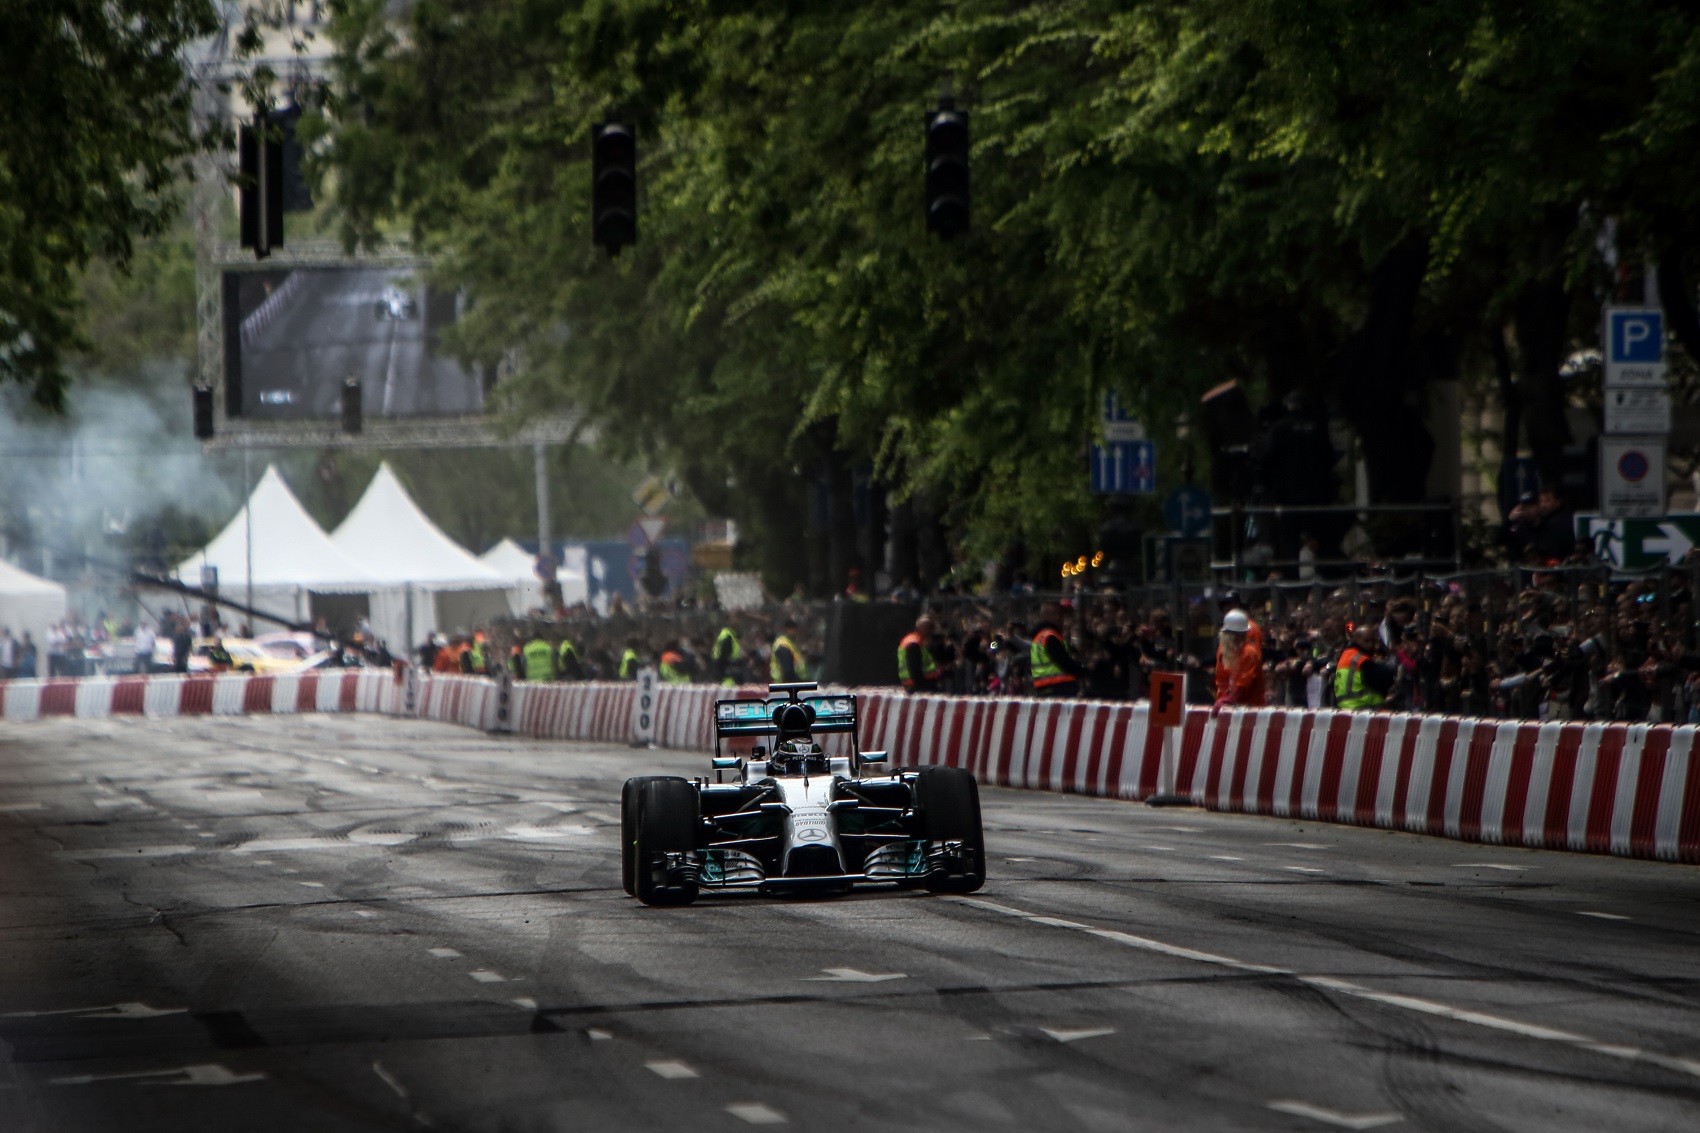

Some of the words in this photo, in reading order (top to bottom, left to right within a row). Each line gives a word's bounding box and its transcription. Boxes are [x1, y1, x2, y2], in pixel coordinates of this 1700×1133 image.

[1623, 320, 1649, 357] P
[719, 699, 849, 717] PETRAS
[1157, 681, 1175, 714] F
